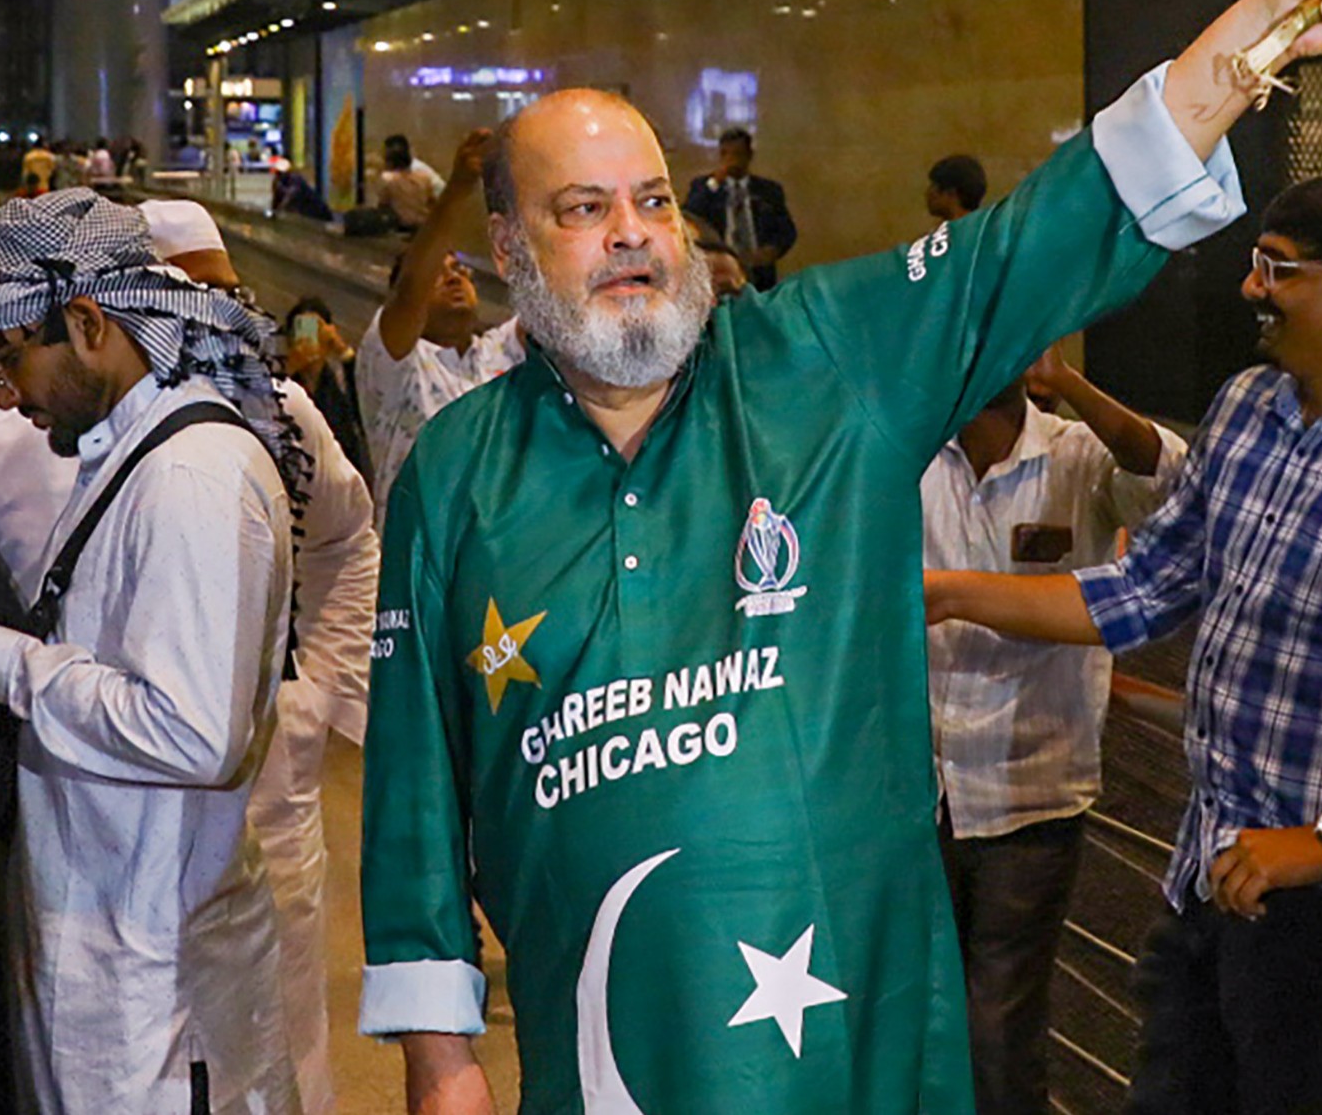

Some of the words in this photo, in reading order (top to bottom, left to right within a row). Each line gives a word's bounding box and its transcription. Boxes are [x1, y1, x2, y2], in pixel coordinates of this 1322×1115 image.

[520, 678, 653, 764] GHAREEB
[663, 646, 786, 711] NAWAZ
[534, 712, 738, 810] CHICAGO
